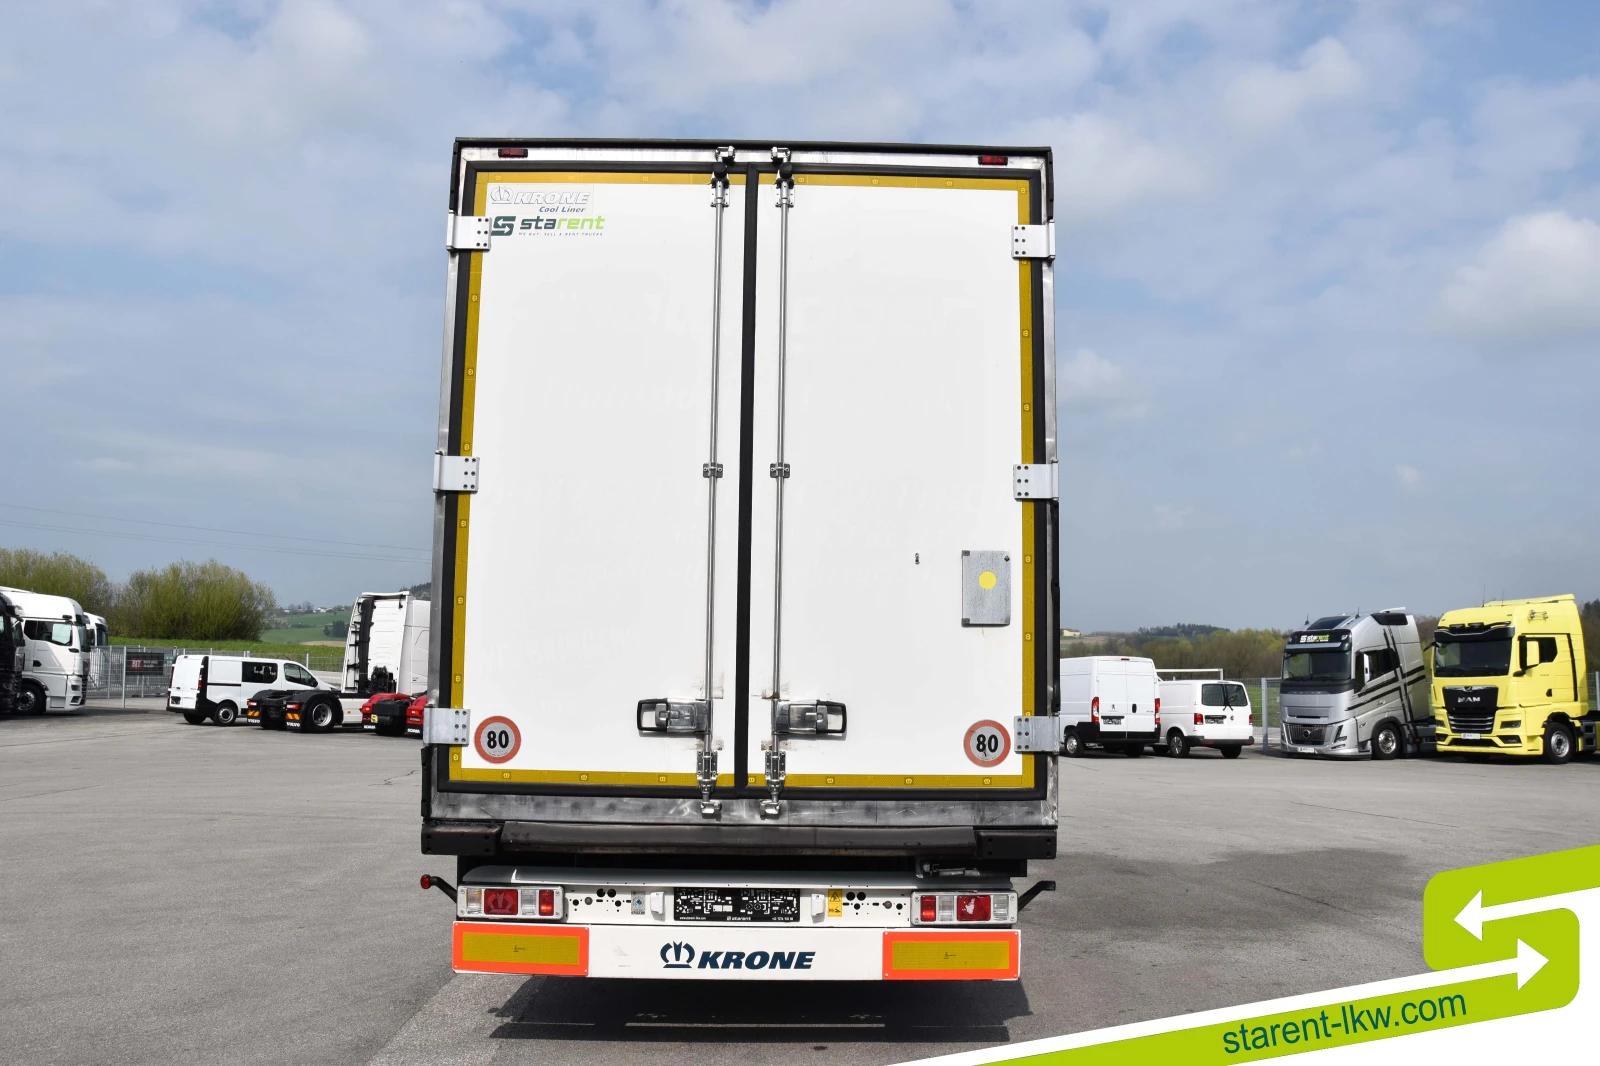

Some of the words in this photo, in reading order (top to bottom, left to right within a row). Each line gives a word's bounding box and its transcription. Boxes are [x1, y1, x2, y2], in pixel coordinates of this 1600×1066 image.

[514, 192, 590, 204] KRONE
[520, 216, 605, 230] starent
[487, 730, 509, 749] 80
[976, 734, 998, 753] 80
[697, 951, 816, 970] KRONE
